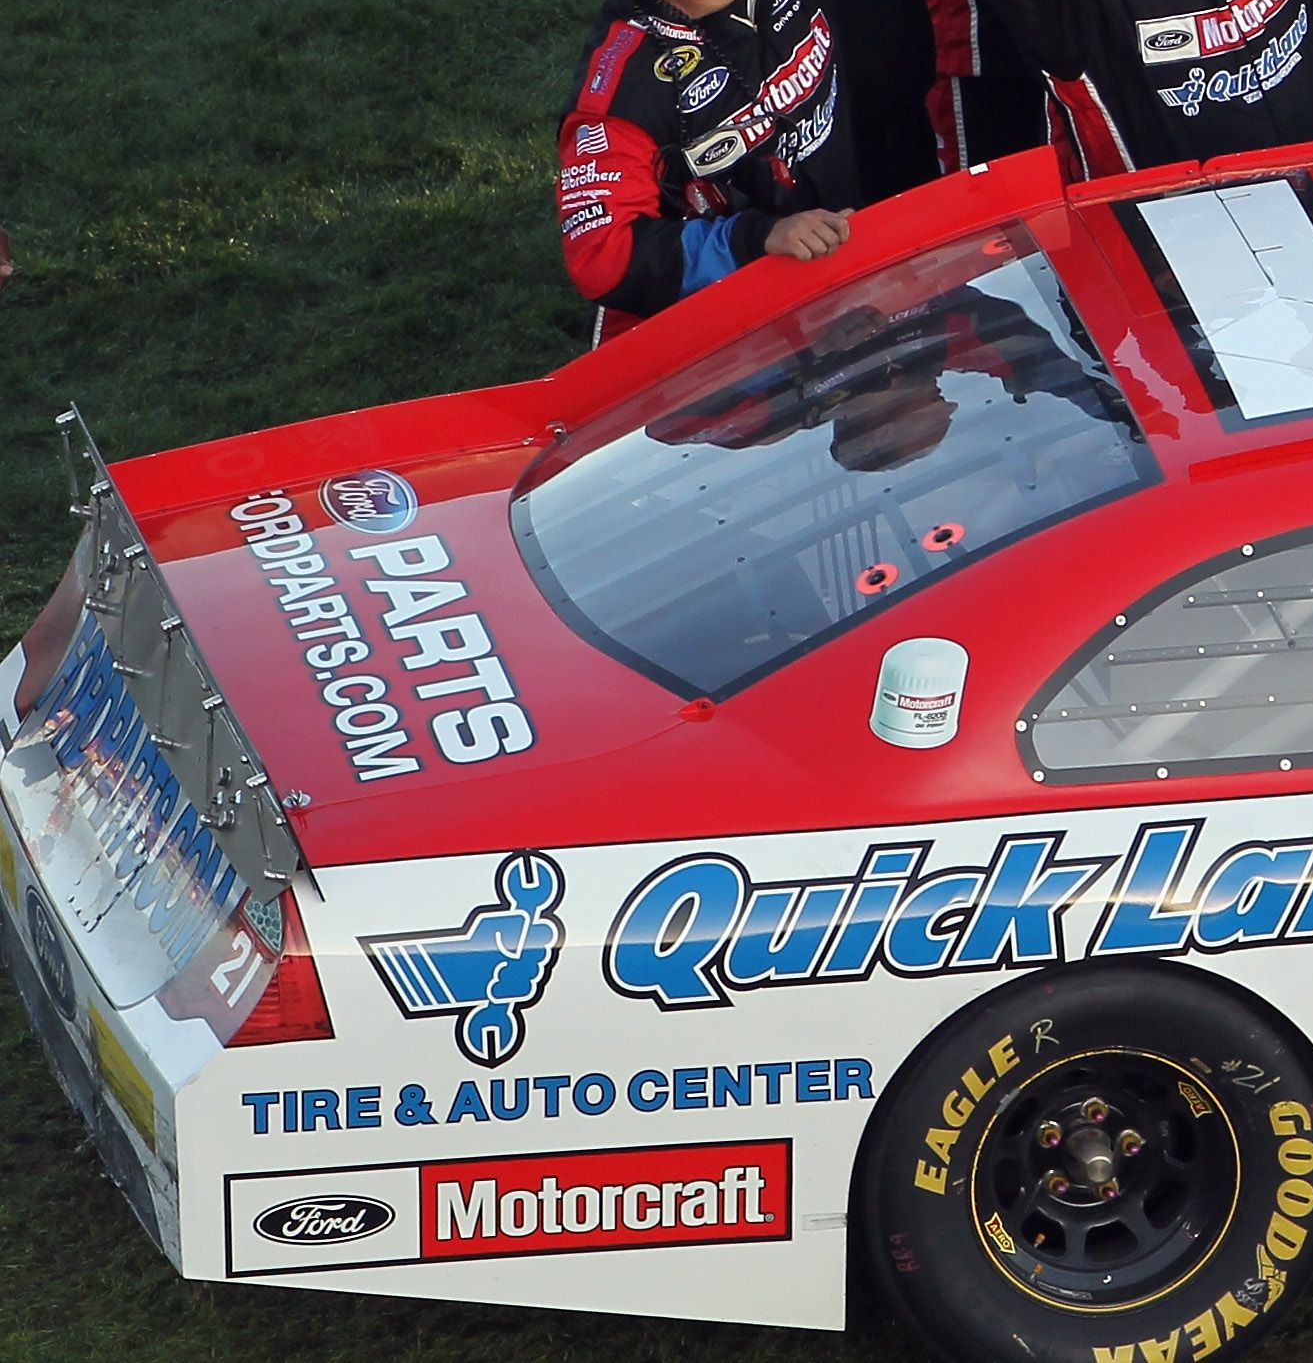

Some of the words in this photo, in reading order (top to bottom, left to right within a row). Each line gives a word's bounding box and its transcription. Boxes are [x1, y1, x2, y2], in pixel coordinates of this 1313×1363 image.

[228, 489, 421, 782] ORDPARTS.COM
[349, 534, 534, 765] PARTS
[209, 929, 264, 1009] 21
[605, 828, 1120, 1011] Quick
[241, 1084, 382, 1135] TIRE
[393, 1082, 434, 1127] &
[446, 1071, 617, 1126] AUTO
[627, 1057, 877, 1114] CENTER
[1029, 1018, 1061, 1054] R
[913, 1034, 1022, 1196] EAGLE
[281, 1199, 368, 1239] Ford
[434, 1165, 767, 1243] Motorcraft
